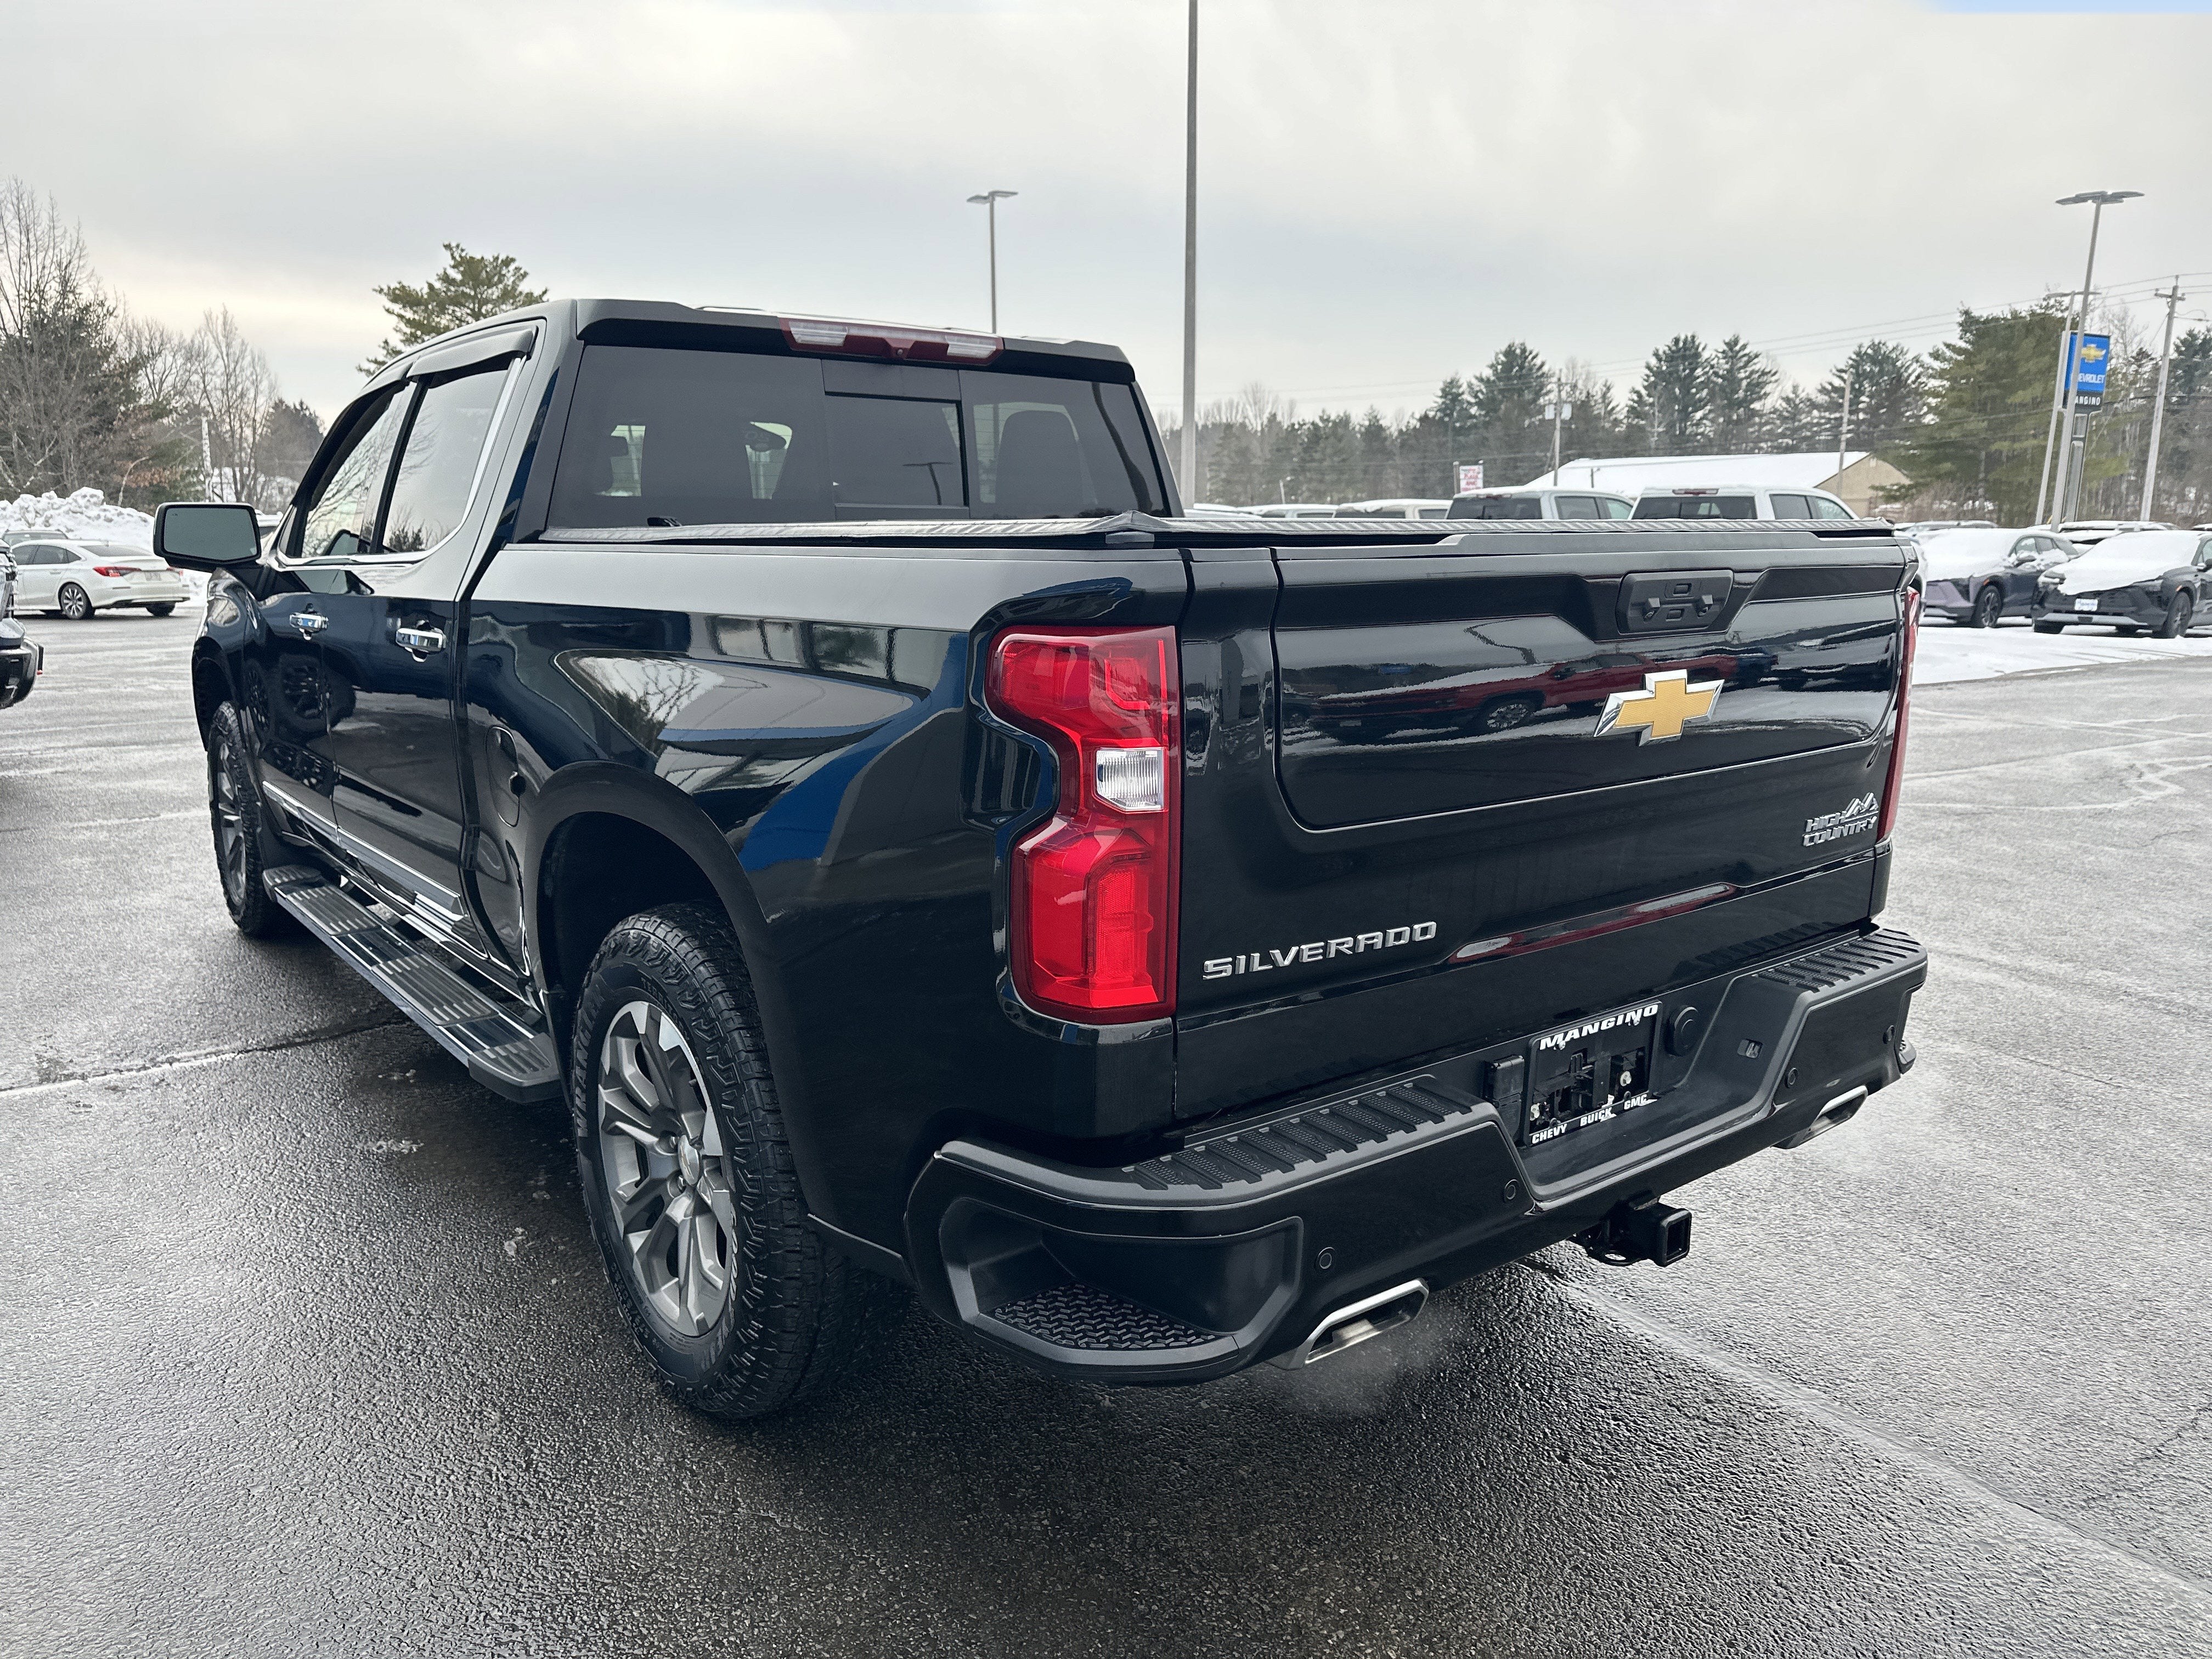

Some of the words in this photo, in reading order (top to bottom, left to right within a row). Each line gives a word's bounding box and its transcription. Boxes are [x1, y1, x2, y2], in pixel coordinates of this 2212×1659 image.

[2078, 373, 2106, 383] EVROLET
[2074, 396, 2101, 405] ANGINO
[1802, 816, 1877, 847] COUNTRY
[1805, 810, 1847, 832] HIGH
[1202, 921, 1437, 980] SILVERADO
[1539, 1004, 1658, 1051] MANGINO
[1532, 1124, 1568, 1144] CHEVY
[1579, 1107, 1613, 1127] BUICK
[1623, 1094, 1647, 1110] GMC
